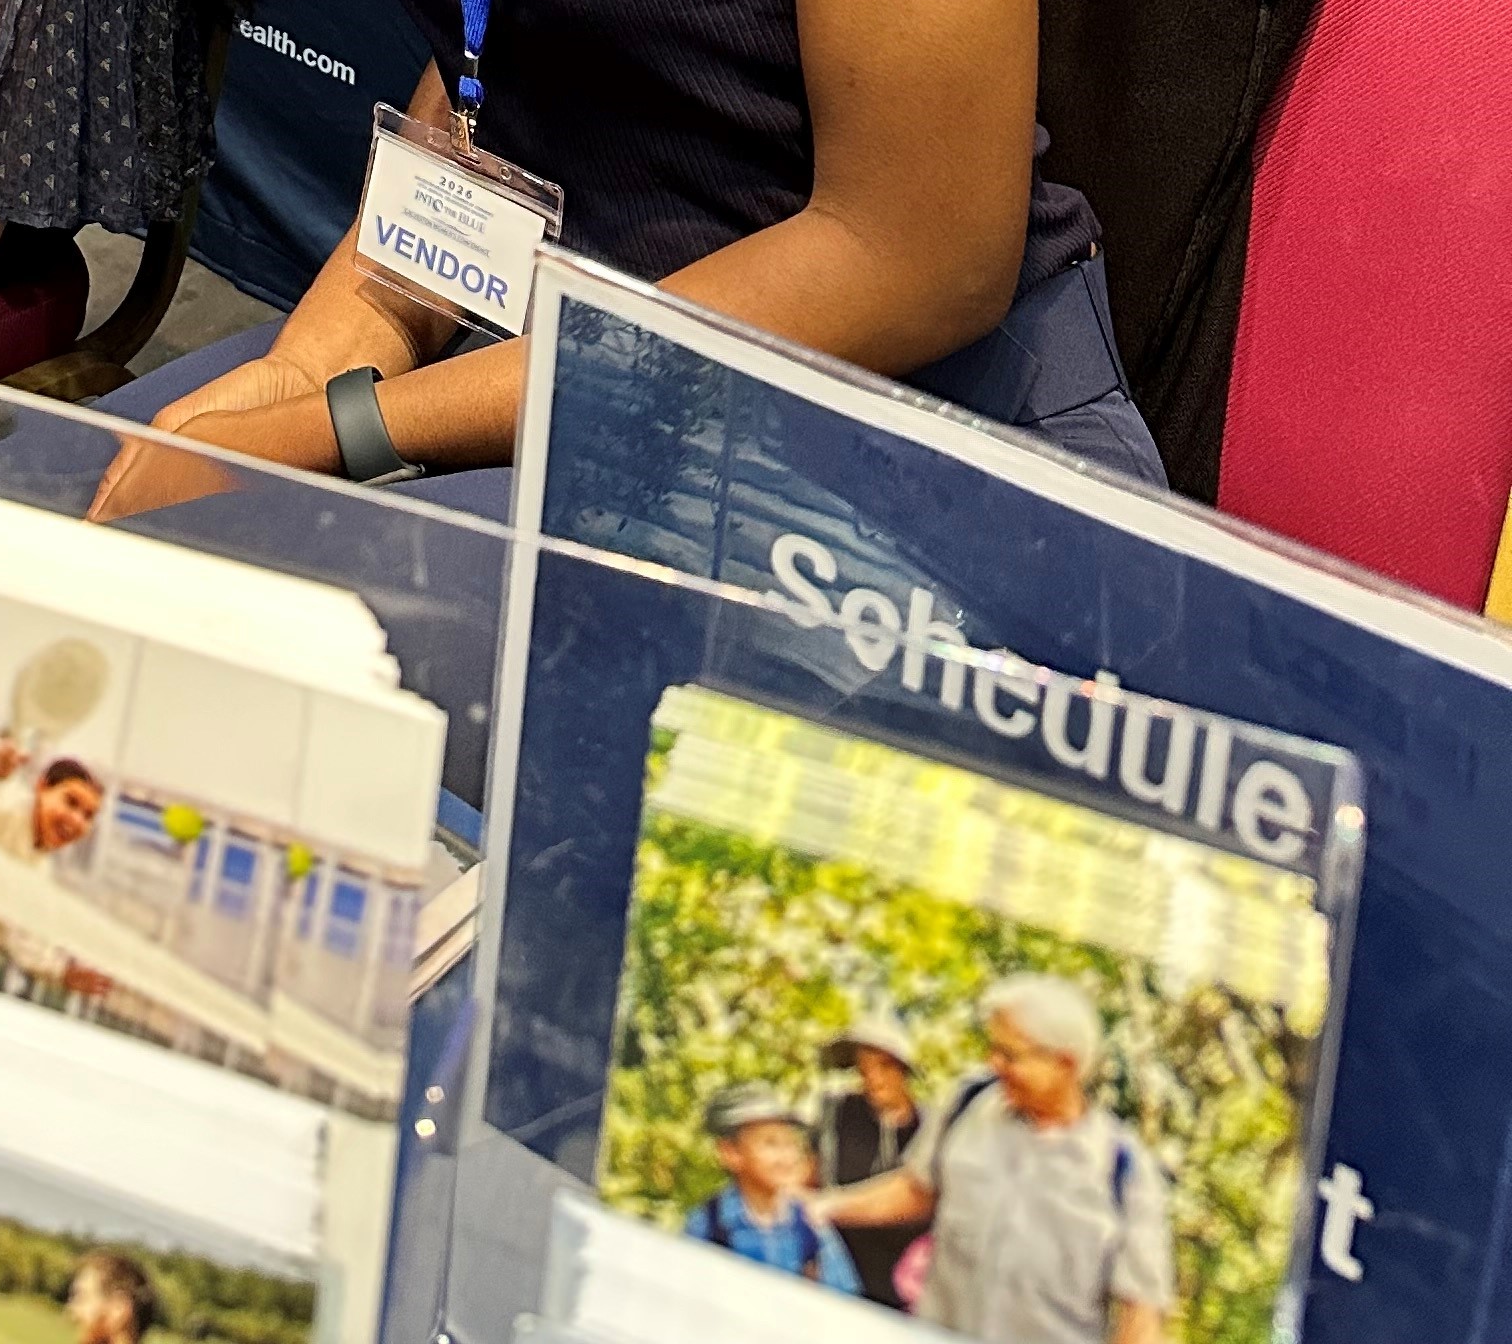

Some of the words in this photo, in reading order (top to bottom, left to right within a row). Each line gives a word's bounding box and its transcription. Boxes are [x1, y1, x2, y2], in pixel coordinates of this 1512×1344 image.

[439, 175, 473, 200] 2026
[375, 214, 509, 310] VENDOR
[769, 531, 1316, 860] Schedule
